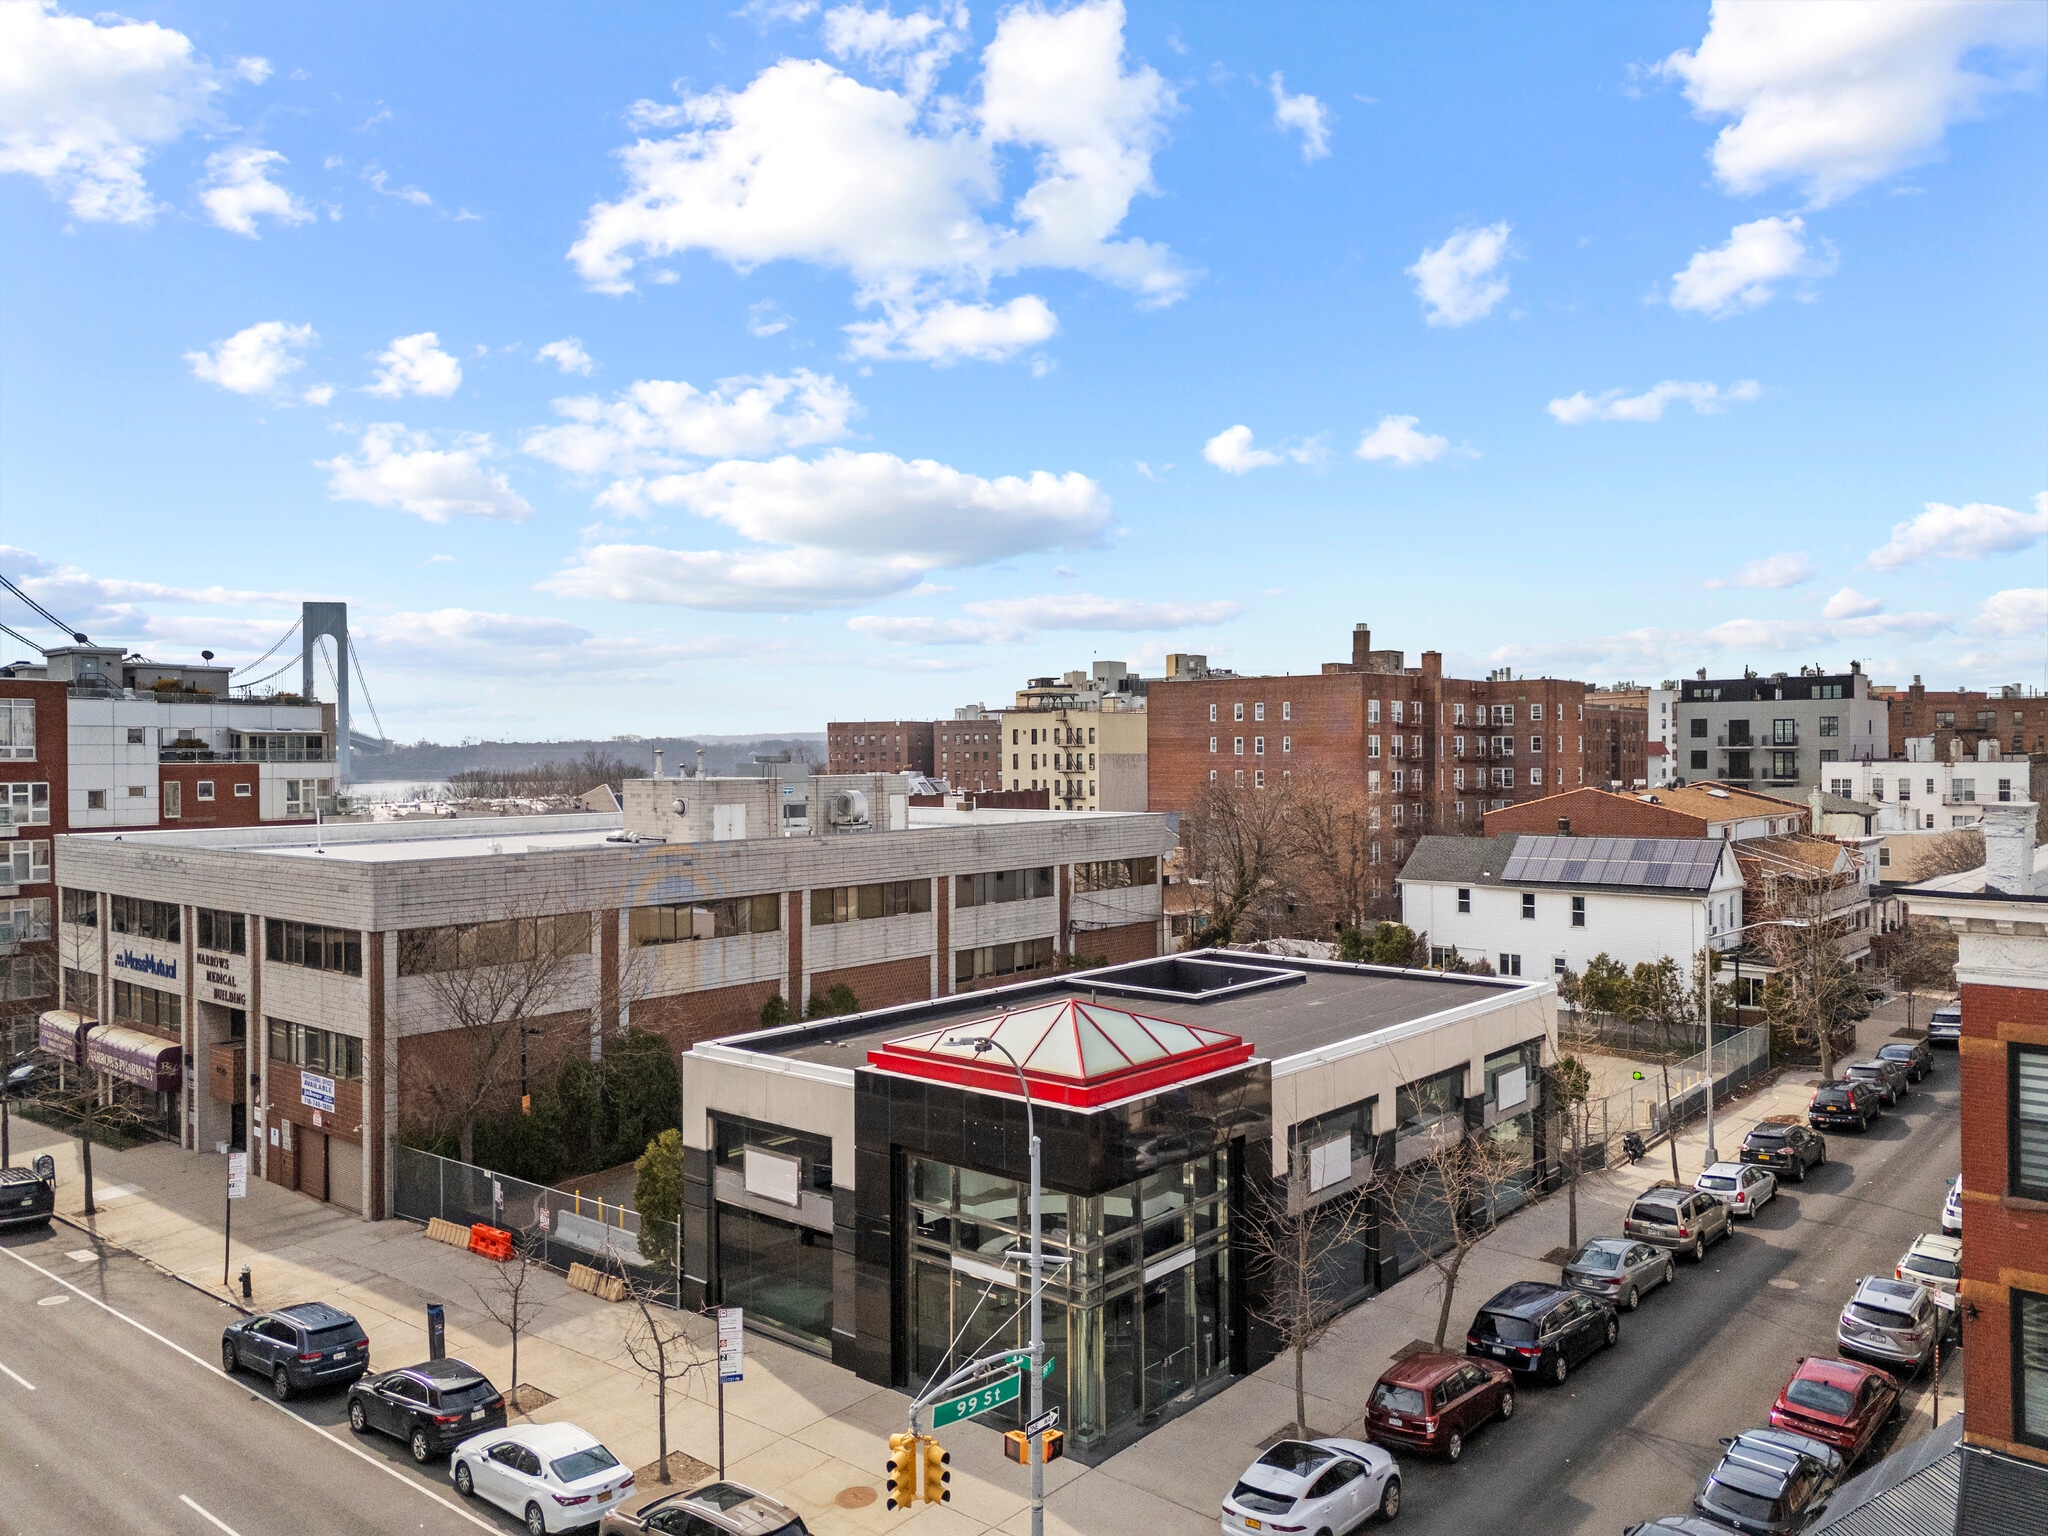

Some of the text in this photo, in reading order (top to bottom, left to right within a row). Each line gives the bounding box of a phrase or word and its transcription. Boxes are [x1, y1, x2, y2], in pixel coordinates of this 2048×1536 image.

[124, 949, 177, 979] MassMutual
[196, 952, 230, 970] NARROWS
[206, 970, 237, 988] MEDICAL
[213, 988, 246, 1006] BUILDING
[119, 1059, 155, 1082] PHARMACY
[304, 1080, 332, 1094] AVAILABLE
[957, 1387, 1000, 1417] 99 St
[1028, 1414, 1054, 1434] ONE WAY
